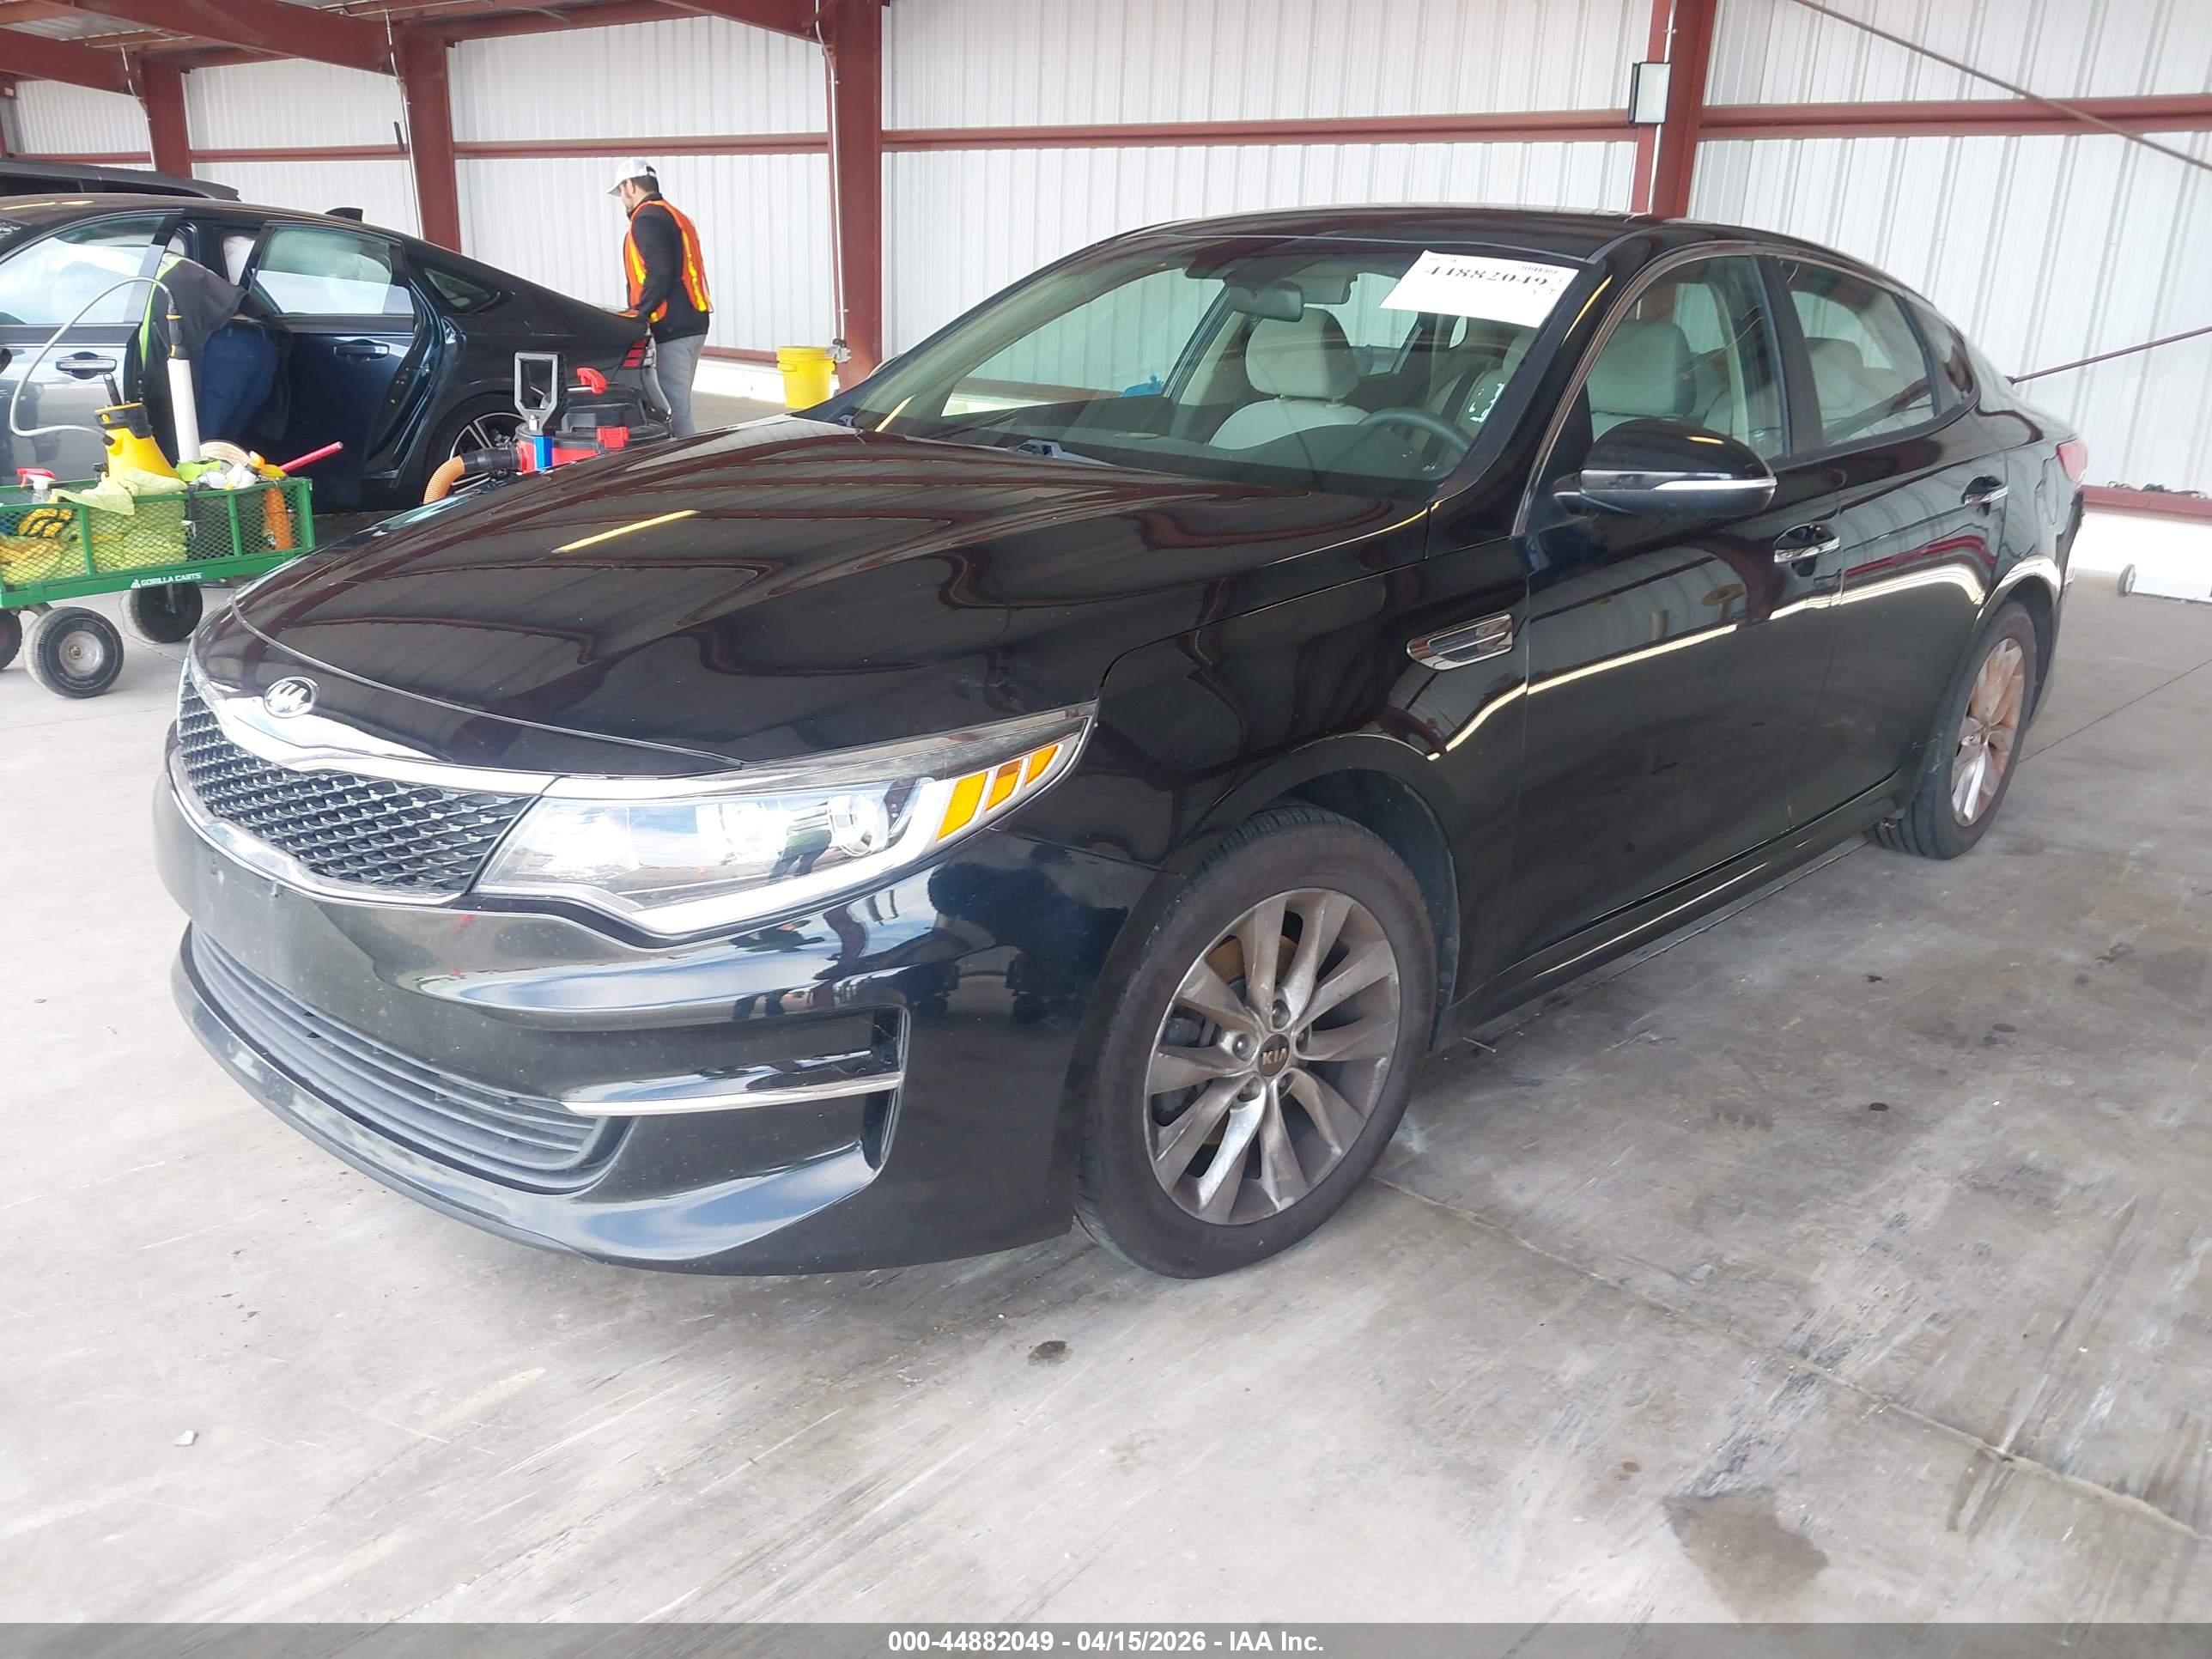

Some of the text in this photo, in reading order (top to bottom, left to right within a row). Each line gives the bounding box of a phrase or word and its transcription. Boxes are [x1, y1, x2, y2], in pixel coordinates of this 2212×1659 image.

[140, 572, 203, 586] GORILLA CARTS
[1262, 1048, 1286, 1066] KIA
